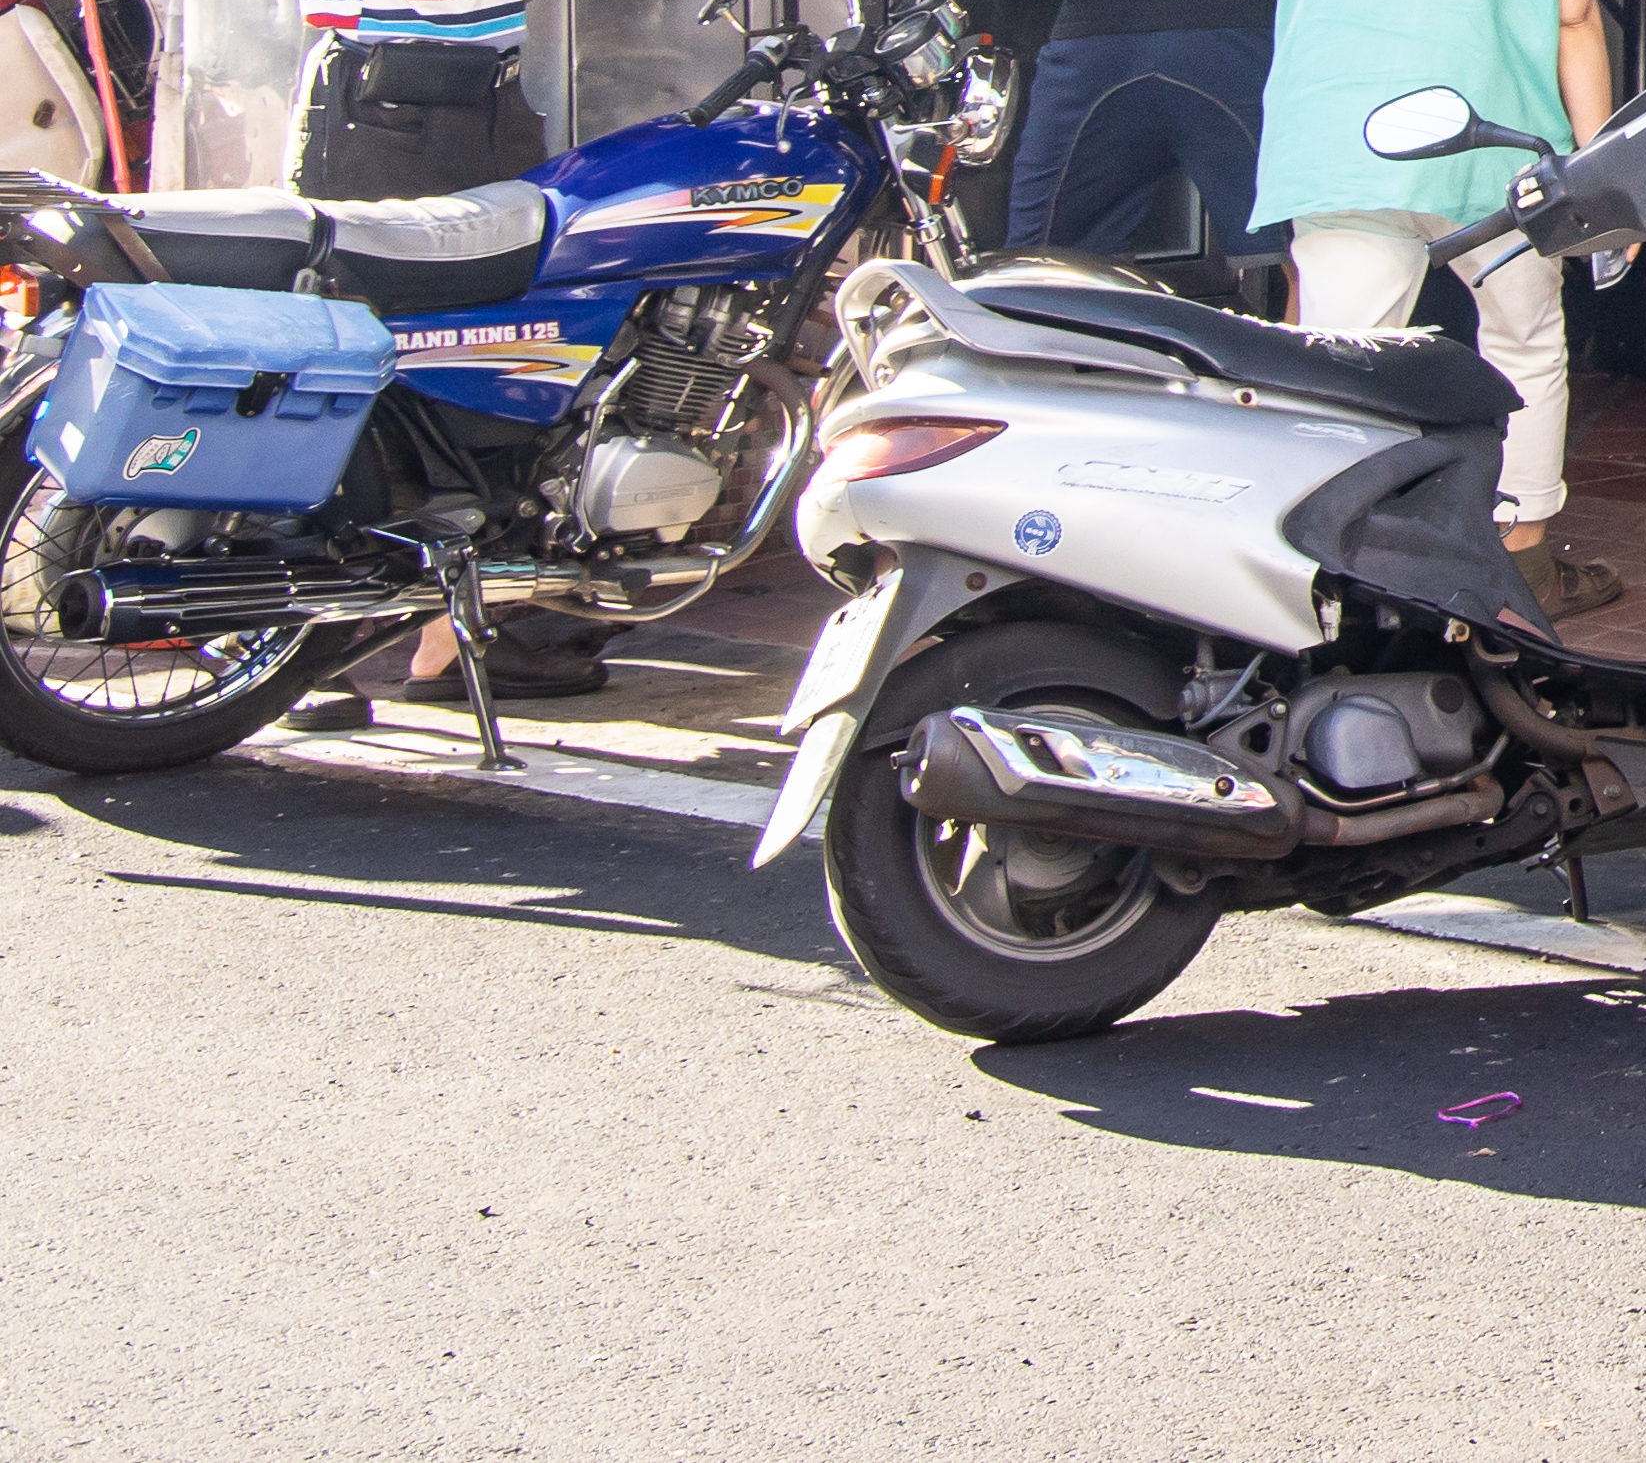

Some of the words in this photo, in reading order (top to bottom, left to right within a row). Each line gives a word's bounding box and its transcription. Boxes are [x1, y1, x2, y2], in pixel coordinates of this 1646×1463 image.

[689, 177, 803, 208] KYMCO
[462, 324, 517, 346] KING
[519, 321, 560, 342] 125
